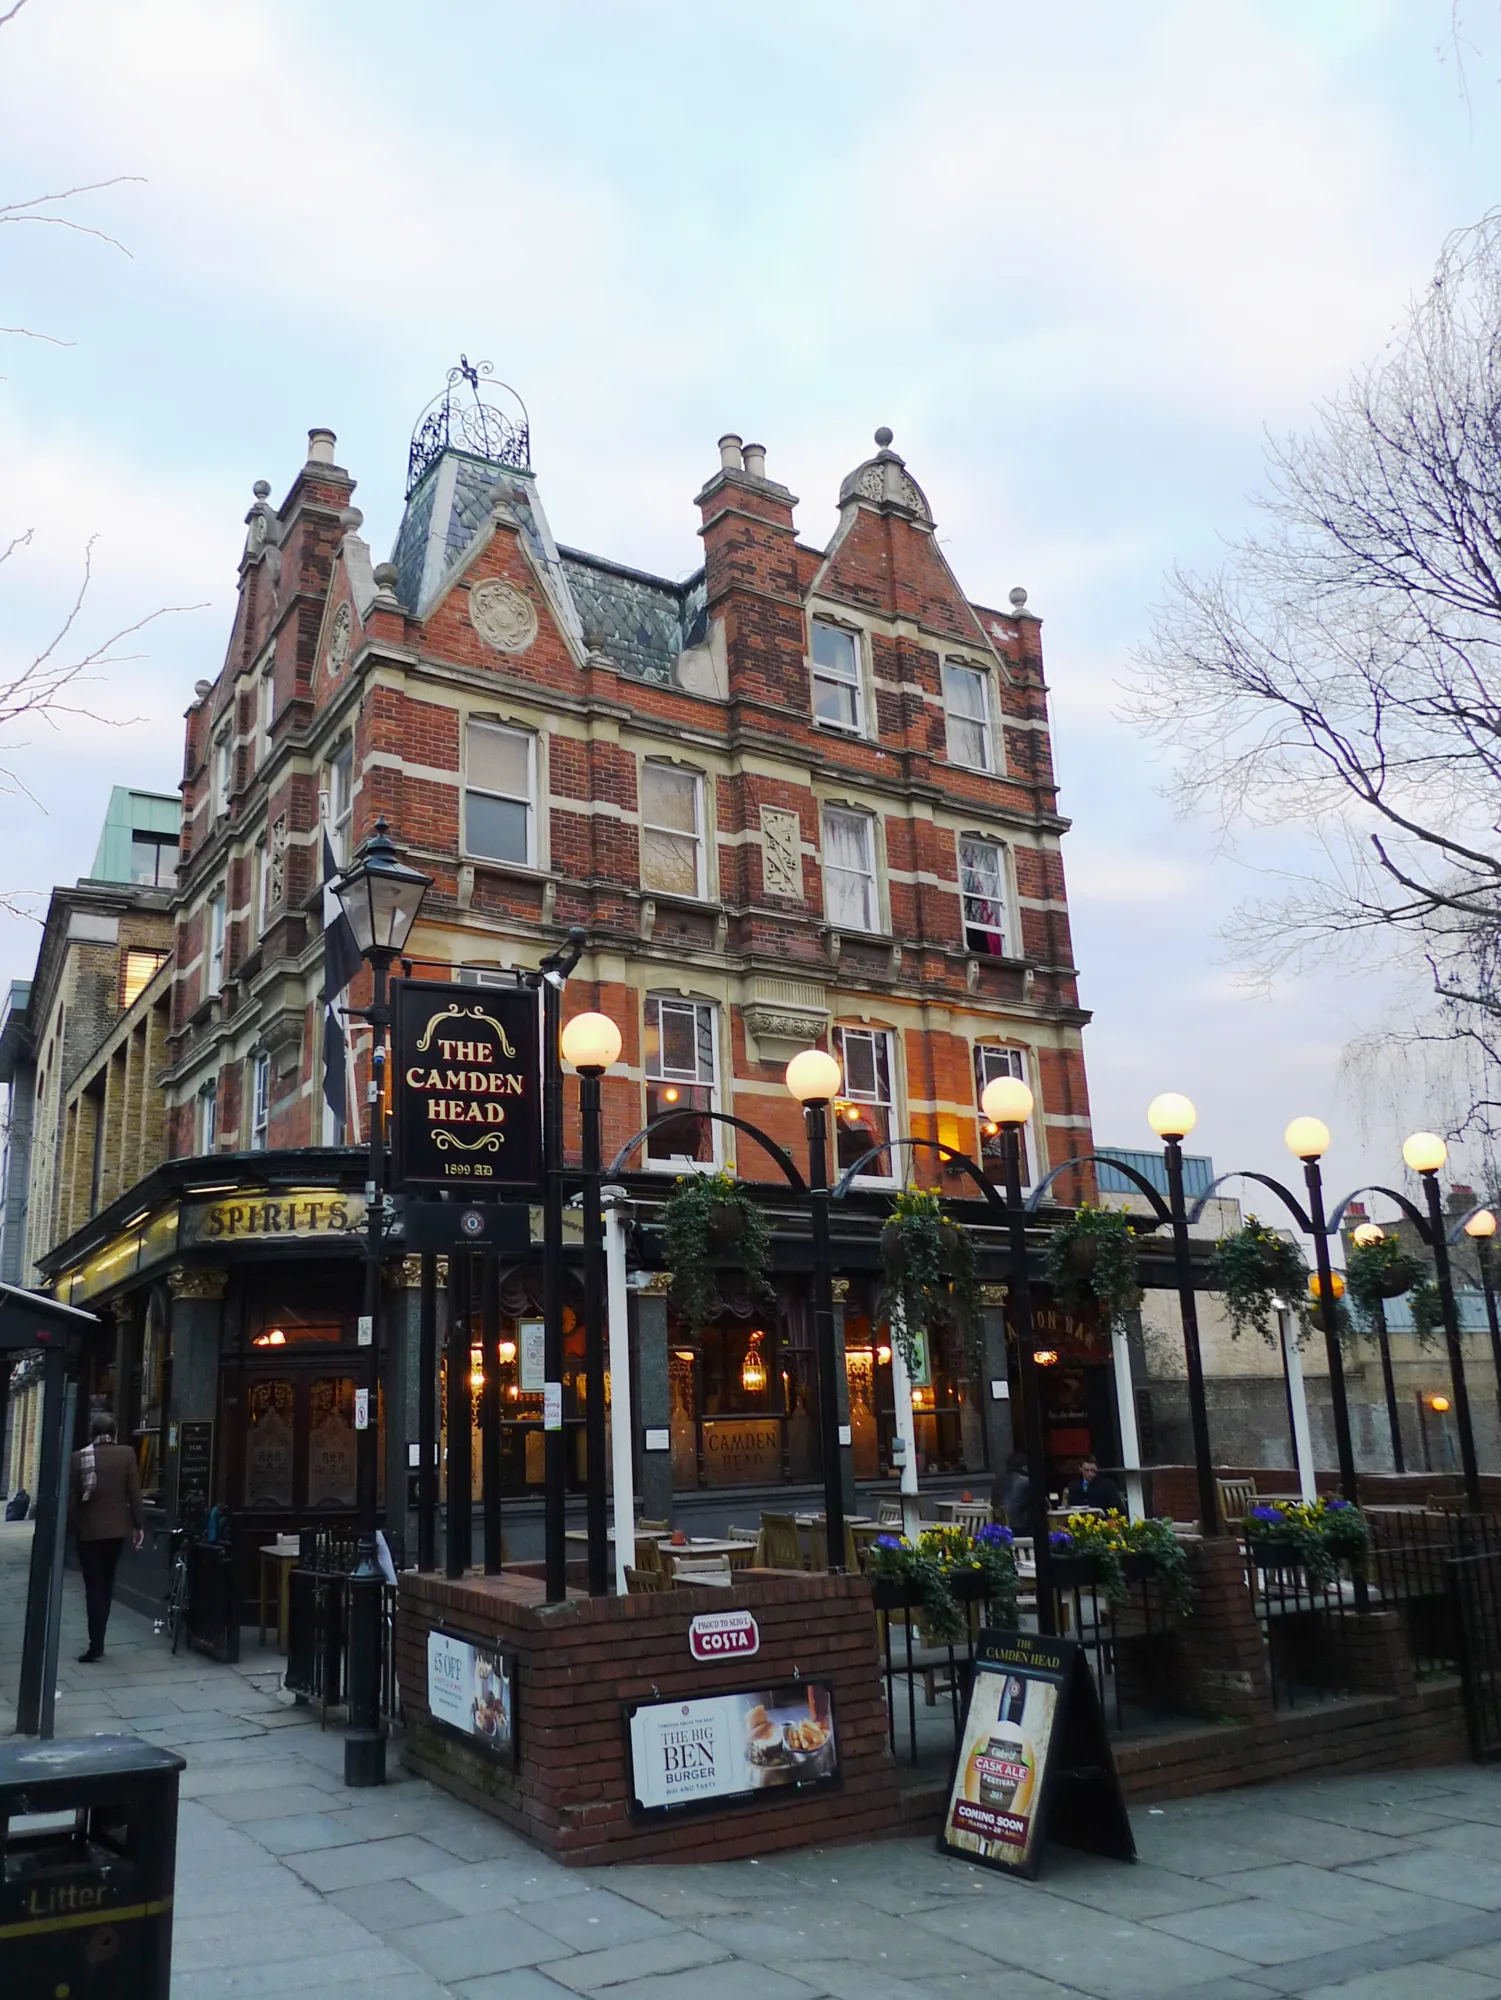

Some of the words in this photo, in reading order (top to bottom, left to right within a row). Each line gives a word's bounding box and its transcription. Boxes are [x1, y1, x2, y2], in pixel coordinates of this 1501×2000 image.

[438, 1039, 494, 1063] THE
[406, 1067, 524, 1095] CAMDEN
[427, 1099, 506, 1123] HEAD
[444, 1163, 471, 1176] 1899
[208, 1201, 349, 1237] SPIRITS
[708, 1432, 776, 1452] CAMDEN
[698, 1620, 720, 1631] PROUD
[720, 1619, 729, 1628] TO
[729, 1617, 749, 1627] SERVE
[701, 1631, 749, 1650] COSTA
[1016, 1639, 1033, 1650] THE
[444, 1655, 462, 1681] OFF
[986, 1647, 1028, 1664] CAMDEN
[1030, 1653, 1060, 1669] HEAD
[661, 1730, 688, 1746] THE
[691, 1726, 713, 1742] BIG
[663, 1741, 716, 1771] BEN
[665, 1766, 716, 1784] BURGER
[974, 1758, 1003, 1774] CASK
[1004, 1765, 1026, 1779] ALE
[696, 1781, 716, 1790] TASTY
[982, 1773, 1016, 1788] FESTIVAL
[958, 1806, 995, 1824] COMING
[996, 1817, 1024, 1833] SOON
[29, 1884, 107, 1915] Litter
